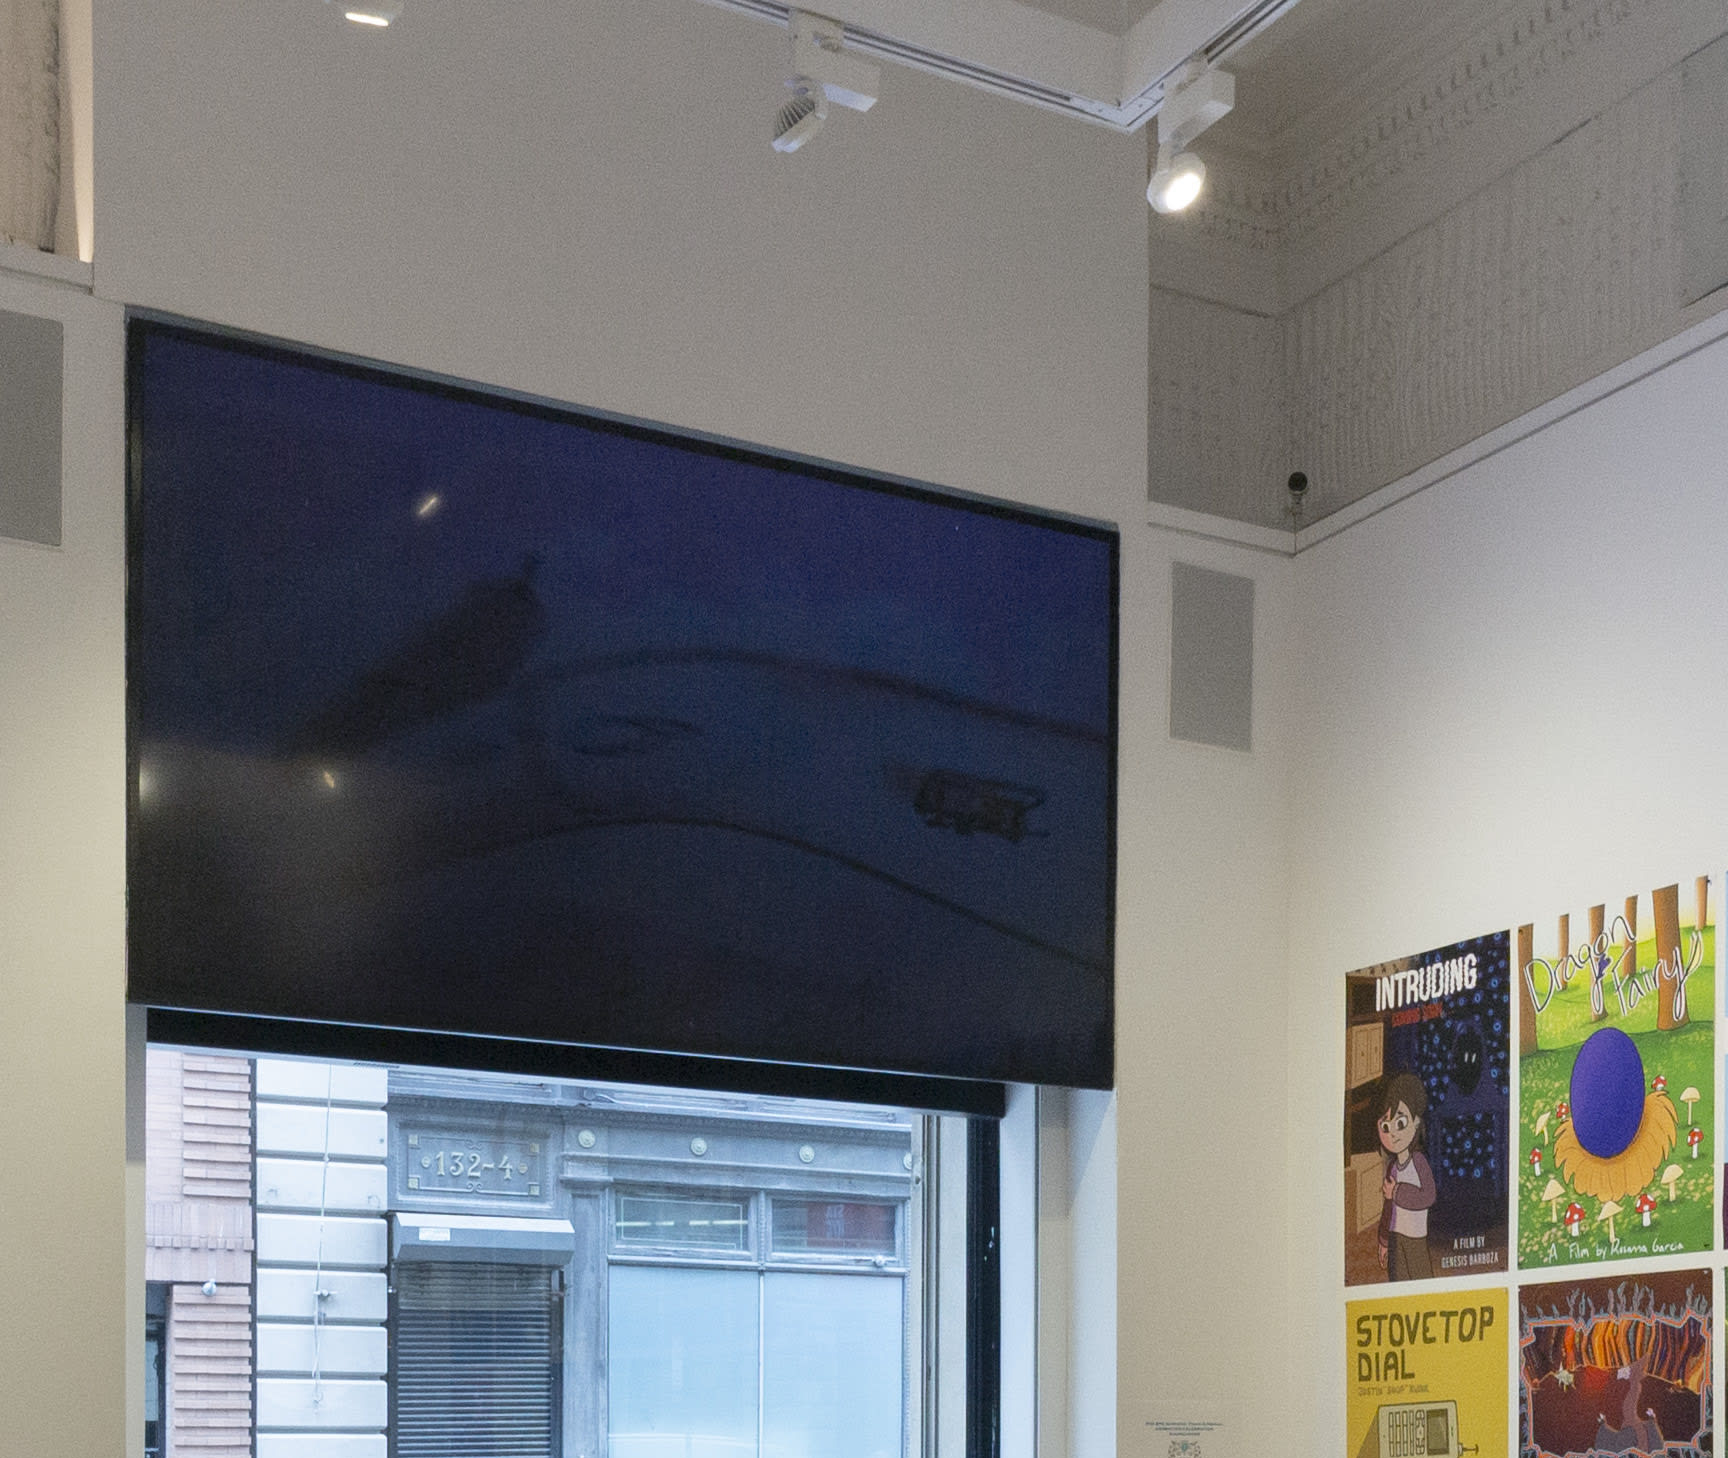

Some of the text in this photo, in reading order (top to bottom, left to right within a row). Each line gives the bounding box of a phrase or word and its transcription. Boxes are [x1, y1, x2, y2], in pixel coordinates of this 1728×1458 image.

[1376, 953, 1478, 1012] INTRUDING
[1524, 915, 1636, 1016] Dragon
[1611, 930, 1704, 1022] Fairy
[1442, 1254, 1468, 1269] GENESIS
[1460, 1237, 1475, 1250] FILM
[1476, 1236, 1485, 1248] BY
[1548, 1243, 1558, 1262] A
[1569, 1242, 1590, 1260] Film
[1595, 1241, 1608, 1259] by
[1652, 1238, 1684, 1252] Garcia
[1356, 1306, 1494, 1348] STOVETOP
[1358, 1350, 1415, 1383] DIAL
